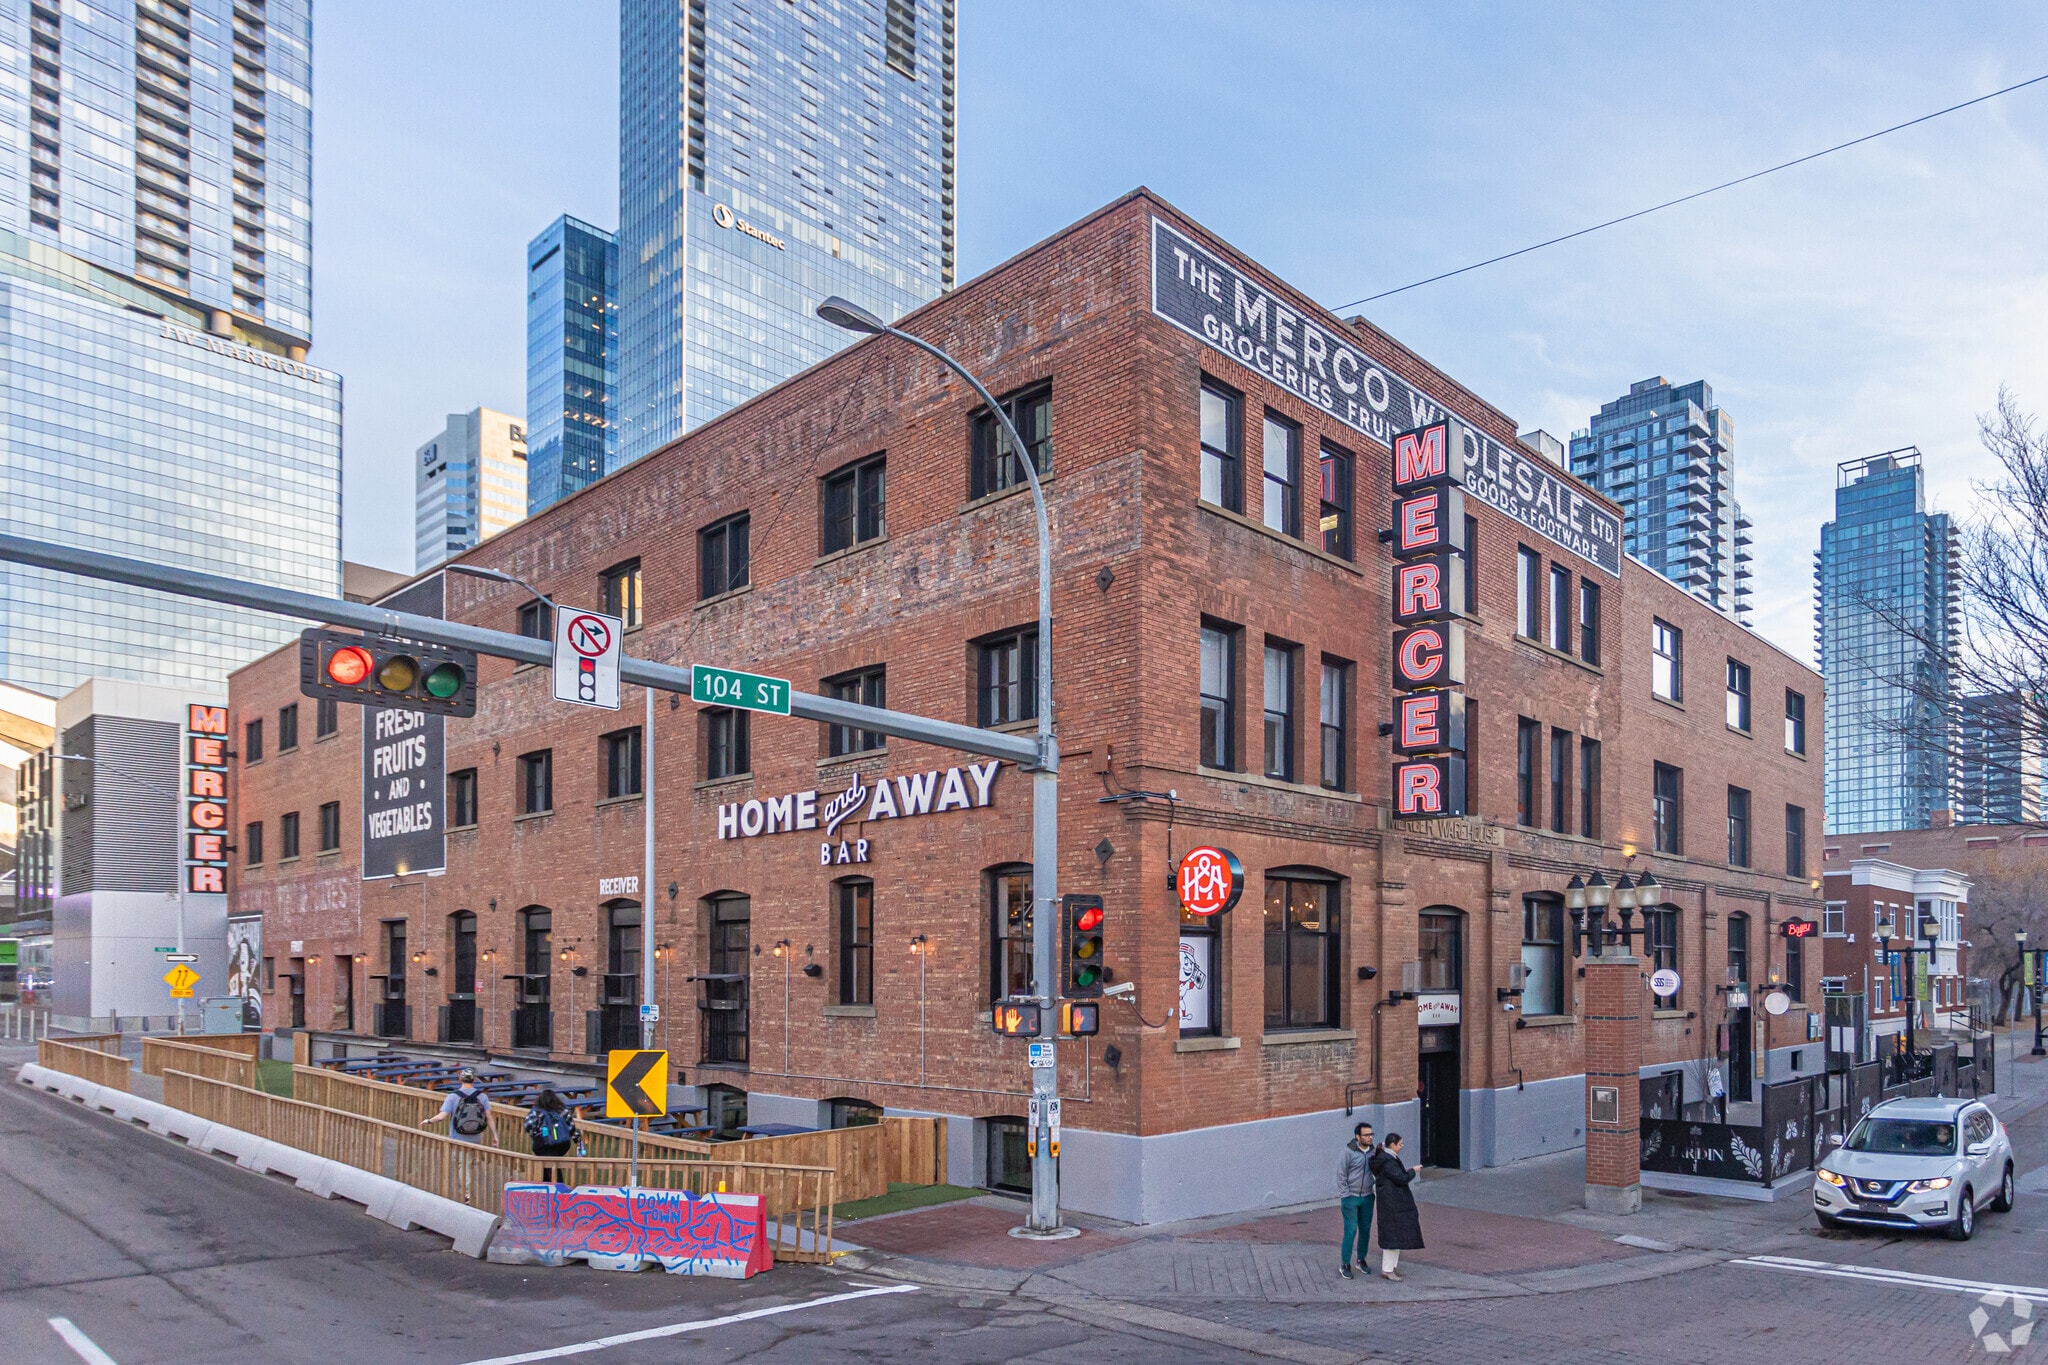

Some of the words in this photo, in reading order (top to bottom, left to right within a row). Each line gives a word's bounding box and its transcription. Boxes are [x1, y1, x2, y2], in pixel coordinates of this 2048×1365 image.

[736, 218, 785, 251] Stantec
[160, 323, 197, 346] JW
[205, 338, 323, 384] MARRIOTT
[1173, 246, 1223, 304] THE
[1234, 278, 1390, 413] MERCO
[1408, 391, 1584, 535] WOLESALE
[1590, 512, 1616, 547] LTD.
[1203, 314, 1334, 409] GROCERIES
[1466, 469, 1519, 522] GOODS
[1530, 507, 1600, 562] FOOTWARE
[1395, 424, 1447, 814] MERCER
[703, 673, 743, 701] 104
[756, 682, 781, 706] ST
[376, 708, 425, 740] FRESH
[373, 735, 427, 778] FRUITS
[190, 704, 227, 892] MERCER
[388, 777, 410, 800] AND
[718, 790, 819, 840] HOME
[824, 772, 868, 836] and
[867, 760, 1000, 822] AWAY
[368, 801, 432, 839] VEGETABLES
[1438, 819, 1500, 846] WAREHOUSE
[820, 838, 869, 866] BAR
[599, 875, 639, 895] RECEIVER
[1182, 855, 1228, 902] H&A
[1417, 1002, 1432, 1013] OME
[1440, 1002, 1458, 1013] AWAY
[1668, 1145, 1724, 1162] JRDIN
[637, 1192, 680, 1210] DOWN
[640, 1209, 681, 1225] TOWN
